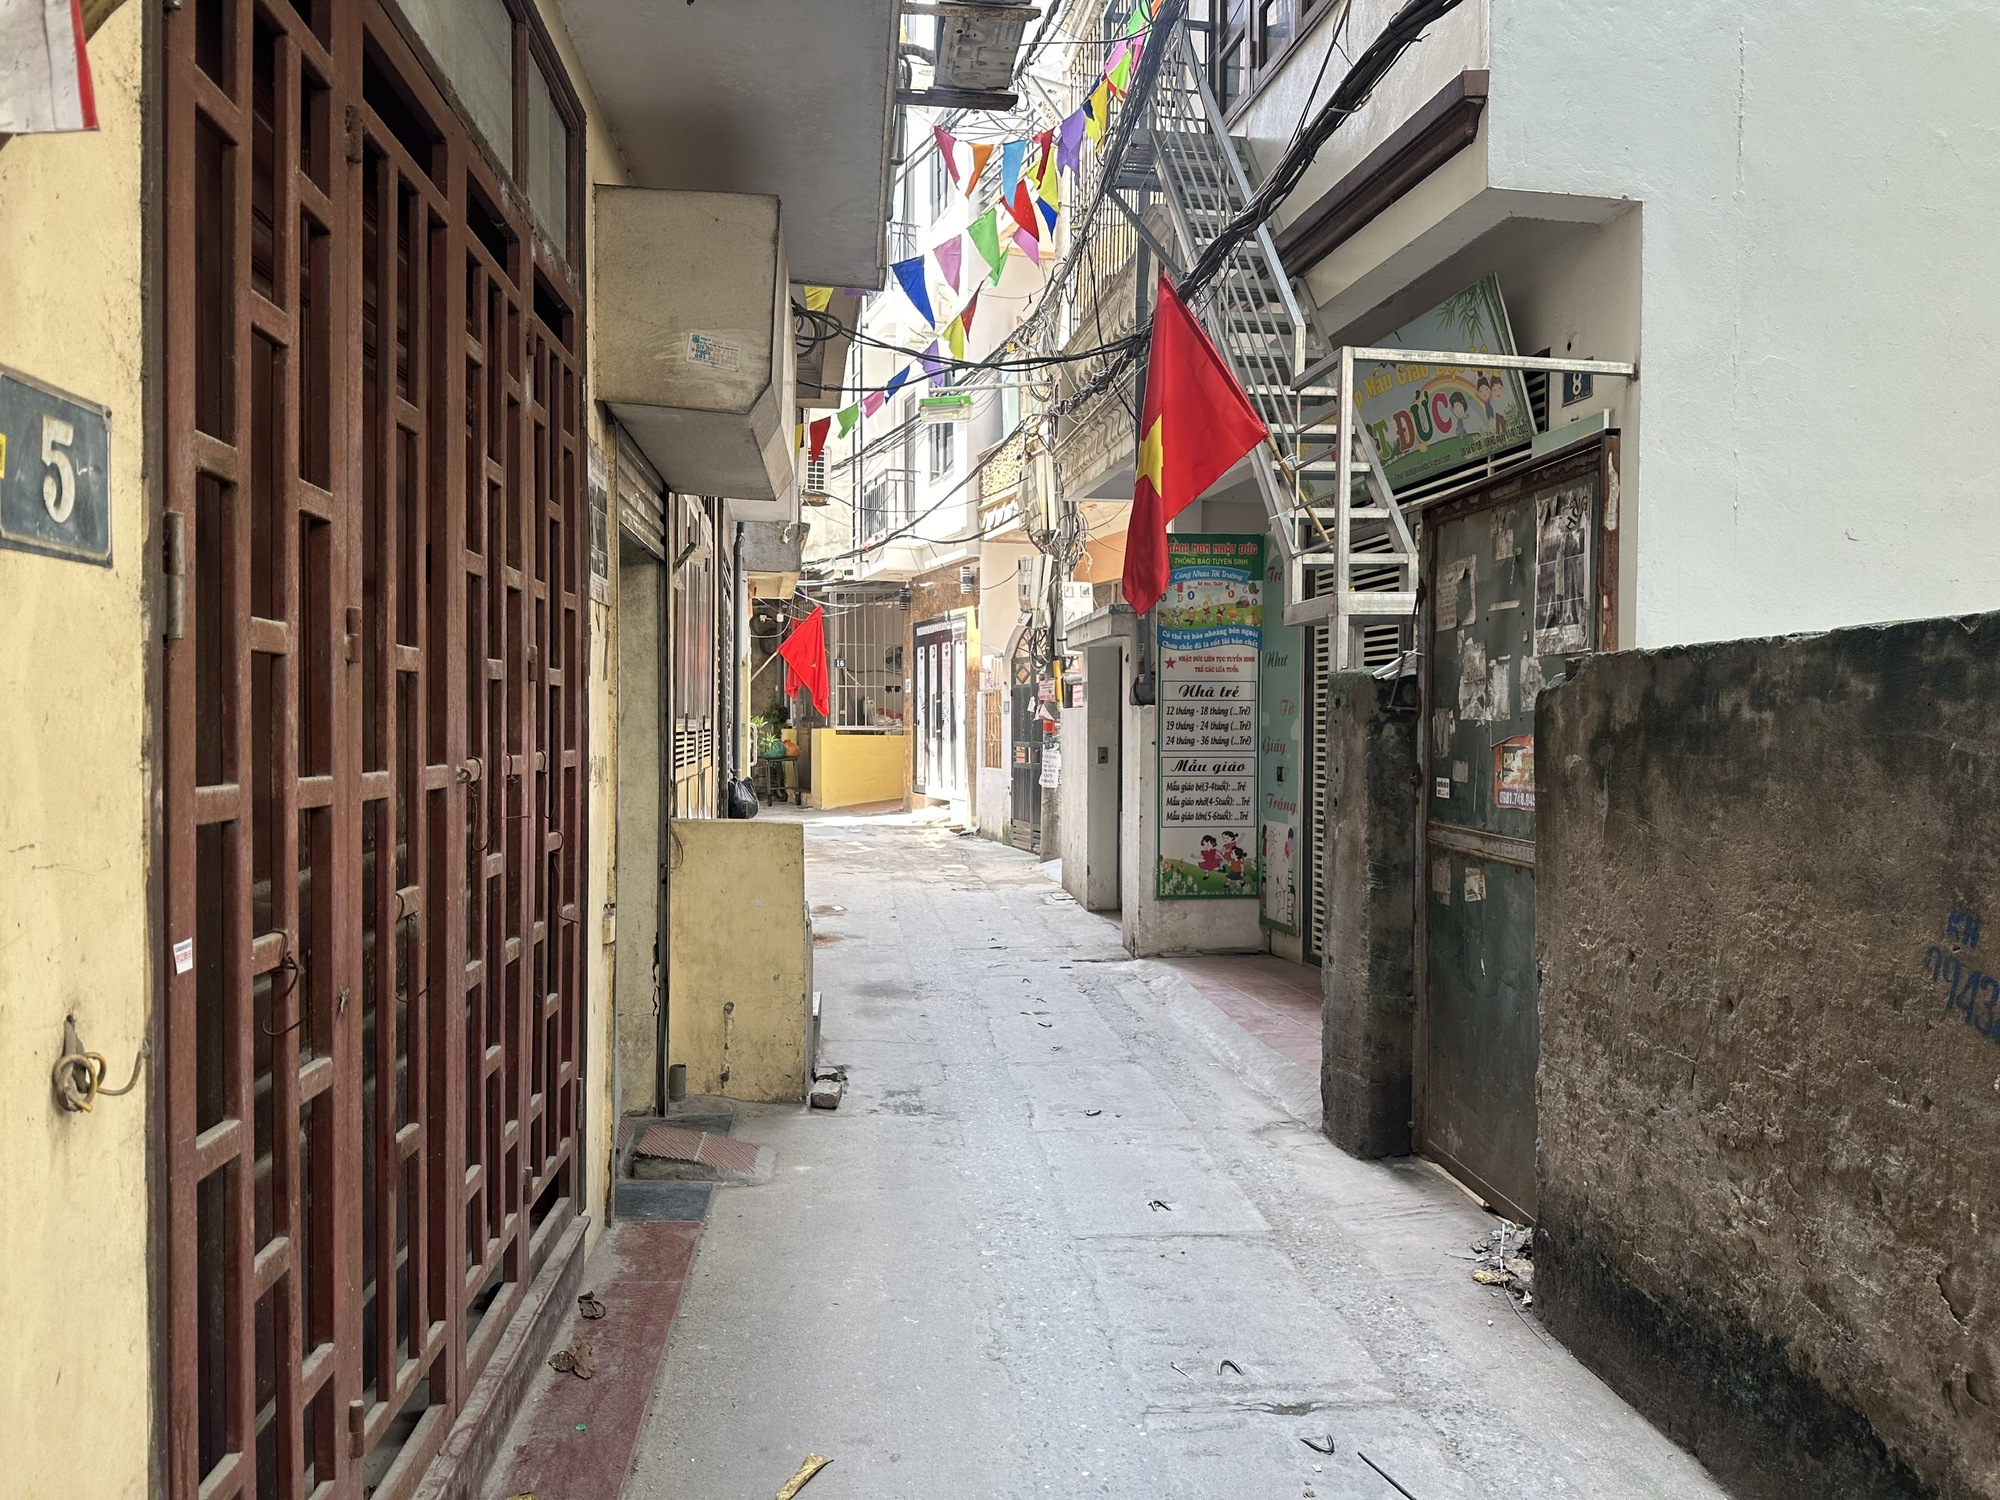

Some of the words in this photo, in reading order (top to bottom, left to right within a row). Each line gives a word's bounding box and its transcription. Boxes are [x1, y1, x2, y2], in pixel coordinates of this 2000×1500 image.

[1572, 372, 1582, 396] 8
[1393, 389, 1453, 452] ĐỨC
[41, 412, 76, 525] 5
[1192, 543, 1211, 555] NON
[1213, 541, 1237, 557] NHẬT
[1239, 541, 1258, 555] ĐỨC
[1174, 556, 1196, 565] THÔNG
[1197, 556, 1211, 565] BÁO
[1212, 556, 1232, 565] TUYỂN
[1174, 571, 1191, 580] Cùng
[1192, 569, 1210, 578] Nhau
[1221, 570, 1243, 581] Trường
[836, 659, 845, 667] 16
[1178, 683, 1215, 698] Nhà
[1219, 685, 1240, 698] trẻ
[1166, 706, 1175, 716] 12
[1175, 706, 1195, 717] tháng
[1200, 706, 1209, 716] 18
[1210, 706, 1229, 717] tháng
[1279, 699, 1296, 717] Tờ
[1166, 720, 1175, 731] 19
[1175, 720, 1195, 732] tháng
[1200, 720, 1209, 731] 24
[1210, 720, 1229, 732] tháng
[1166, 735, 1175, 746] 24
[1176, 735, 1195, 747] tháng
[1200, 735, 1209, 746] 36
[1210, 735, 1229, 747] tháng
[1171, 759, 1208, 772] Mẫu
[1212, 761, 1245, 774] giáo
[1166, 780, 1180, 791] Mẫu
[1181, 782, 1194, 793] giáo
[1166, 795, 1180, 806] Mẫu
[1181, 797, 1194, 808] giáo
[1166, 810, 1180, 821] Mẫu
[1181, 812, 1194, 823] giáo
